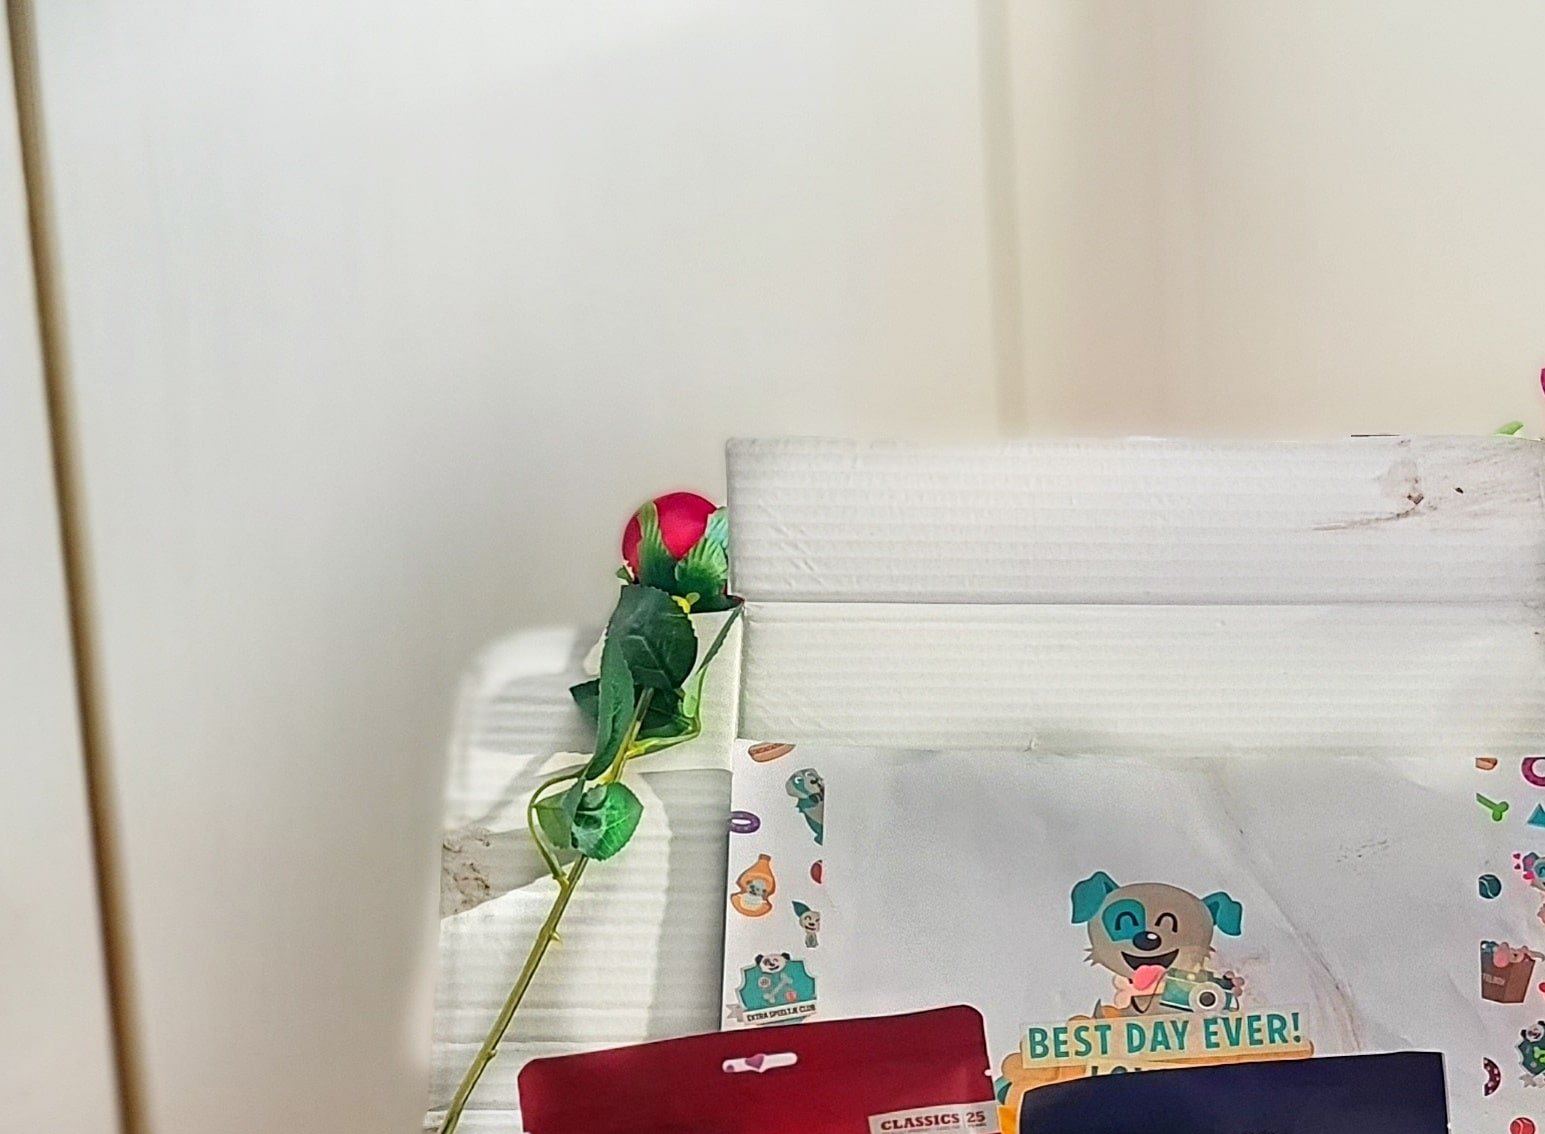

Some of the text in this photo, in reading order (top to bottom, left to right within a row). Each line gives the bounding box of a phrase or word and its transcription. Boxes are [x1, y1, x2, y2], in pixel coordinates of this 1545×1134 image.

[1028, 1012, 1301, 1059] BEST DAY EVER!
[881, 1113, 960, 1131] CLASSICS
[966, 1110, 986, 1123] 25
